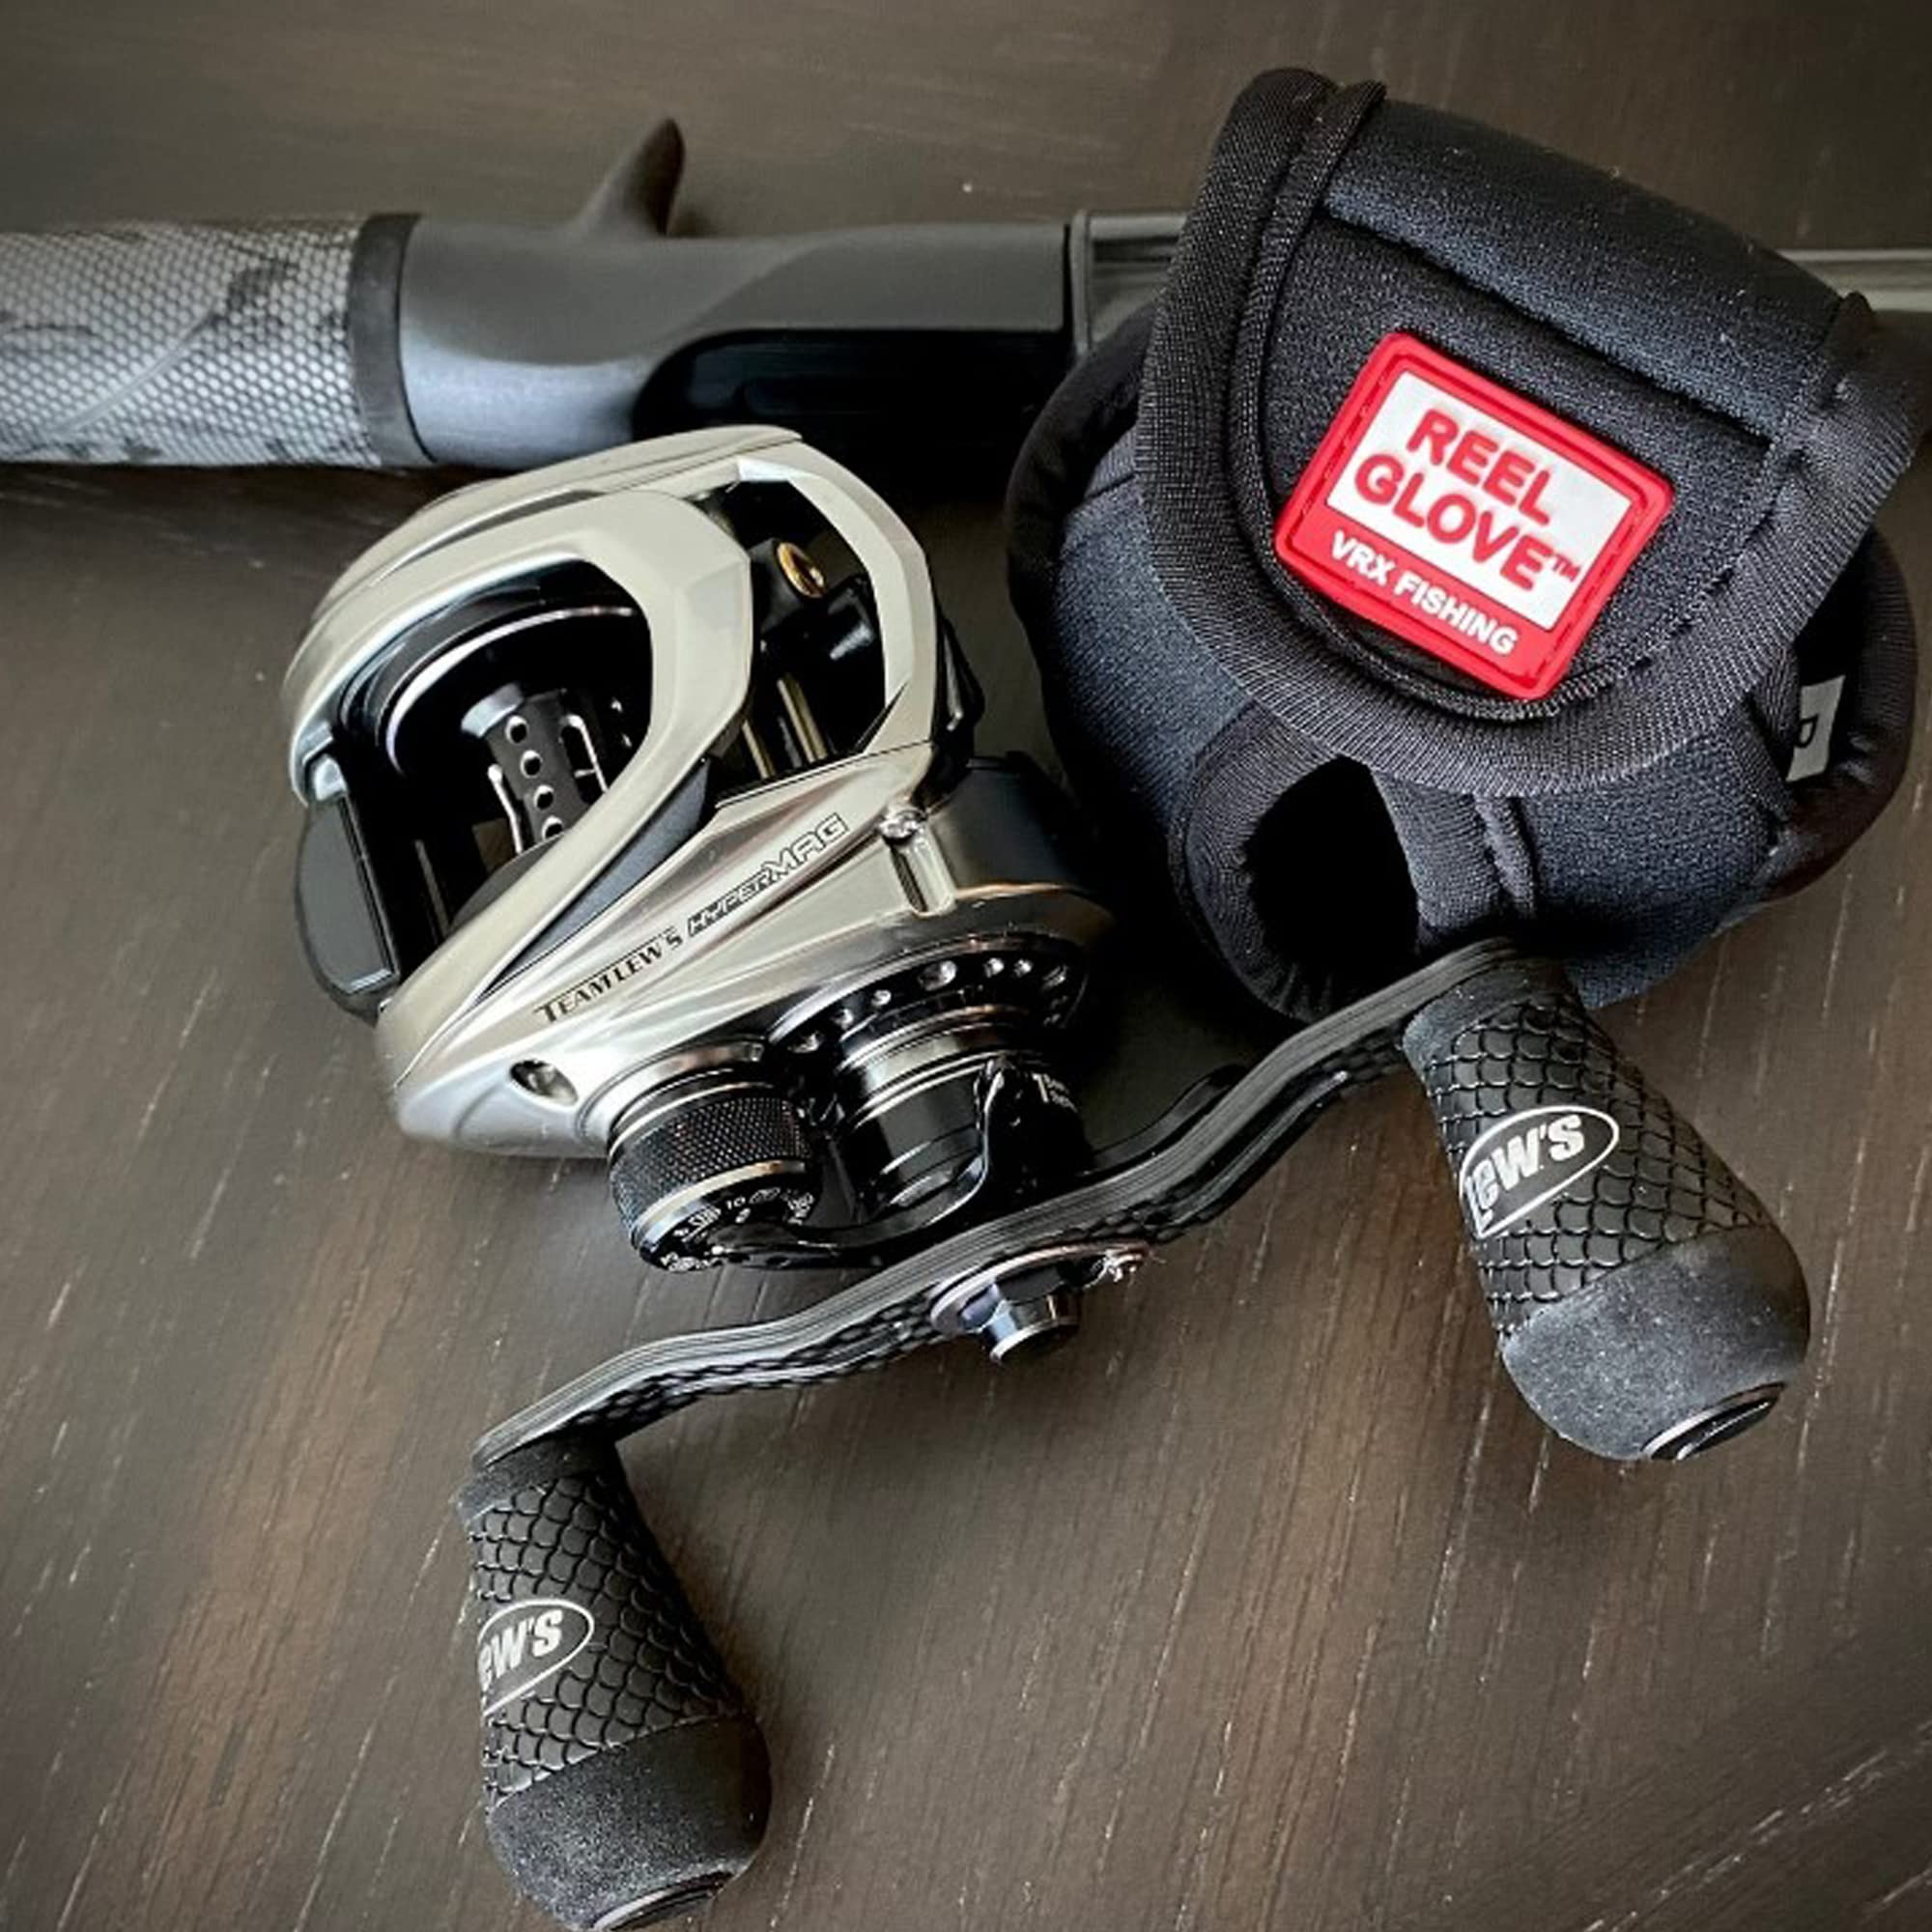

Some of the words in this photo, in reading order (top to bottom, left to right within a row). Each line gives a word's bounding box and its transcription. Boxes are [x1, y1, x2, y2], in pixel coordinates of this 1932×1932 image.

[1406, 409, 1551, 526] REEL
[1330, 529, 1400, 586] VRX
[1394, 573, 1518, 657] FISHING
